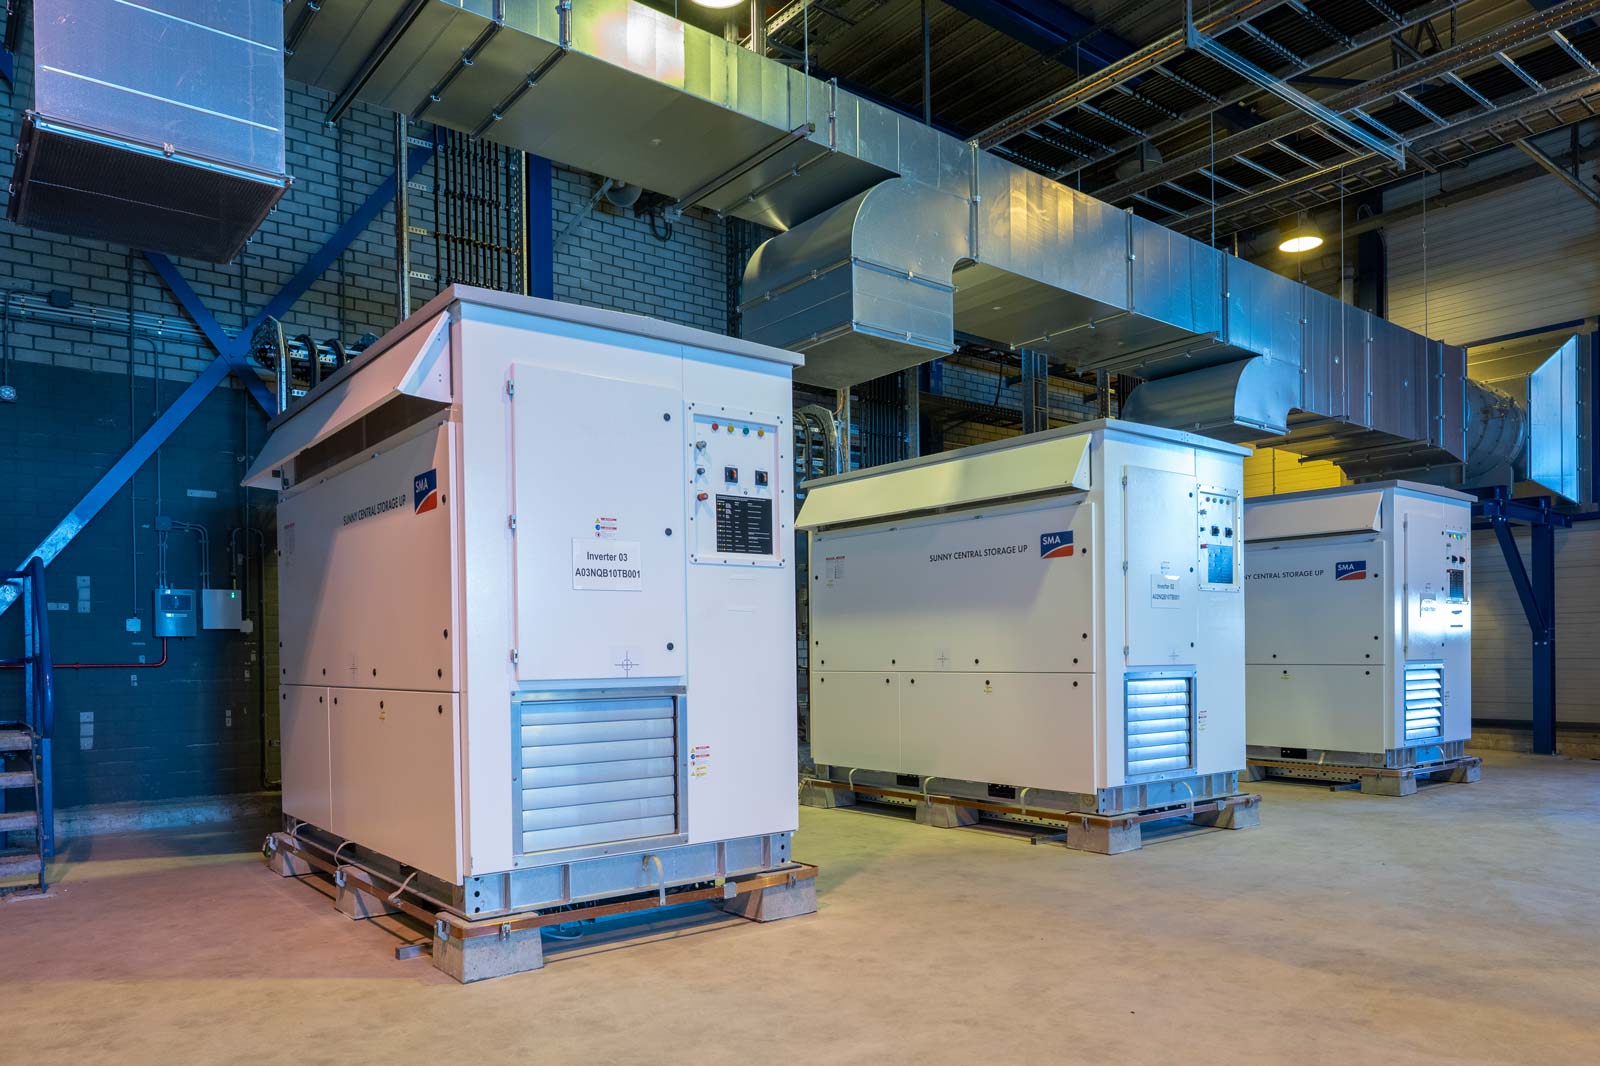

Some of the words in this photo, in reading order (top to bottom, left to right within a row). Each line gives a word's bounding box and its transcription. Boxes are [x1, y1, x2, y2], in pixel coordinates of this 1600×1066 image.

[416, 478, 428, 492] SMA
[1042, 536, 1060, 544] SMA
[586, 552, 616, 561] Inverter
[618, 553, 628, 562] 03
[929, 552, 952, 562] SUNNY
[953, 550, 983, 560] CENTRAL
[984, 546, 1017, 557] STORAGE
[1018, 544, 1028, 552] UP
[575, 568, 640, 578] A03NQB10TB001
[1253, 572, 1281, 580] CENTRAL
[1282, 570, 1313, 578] STORAGE
